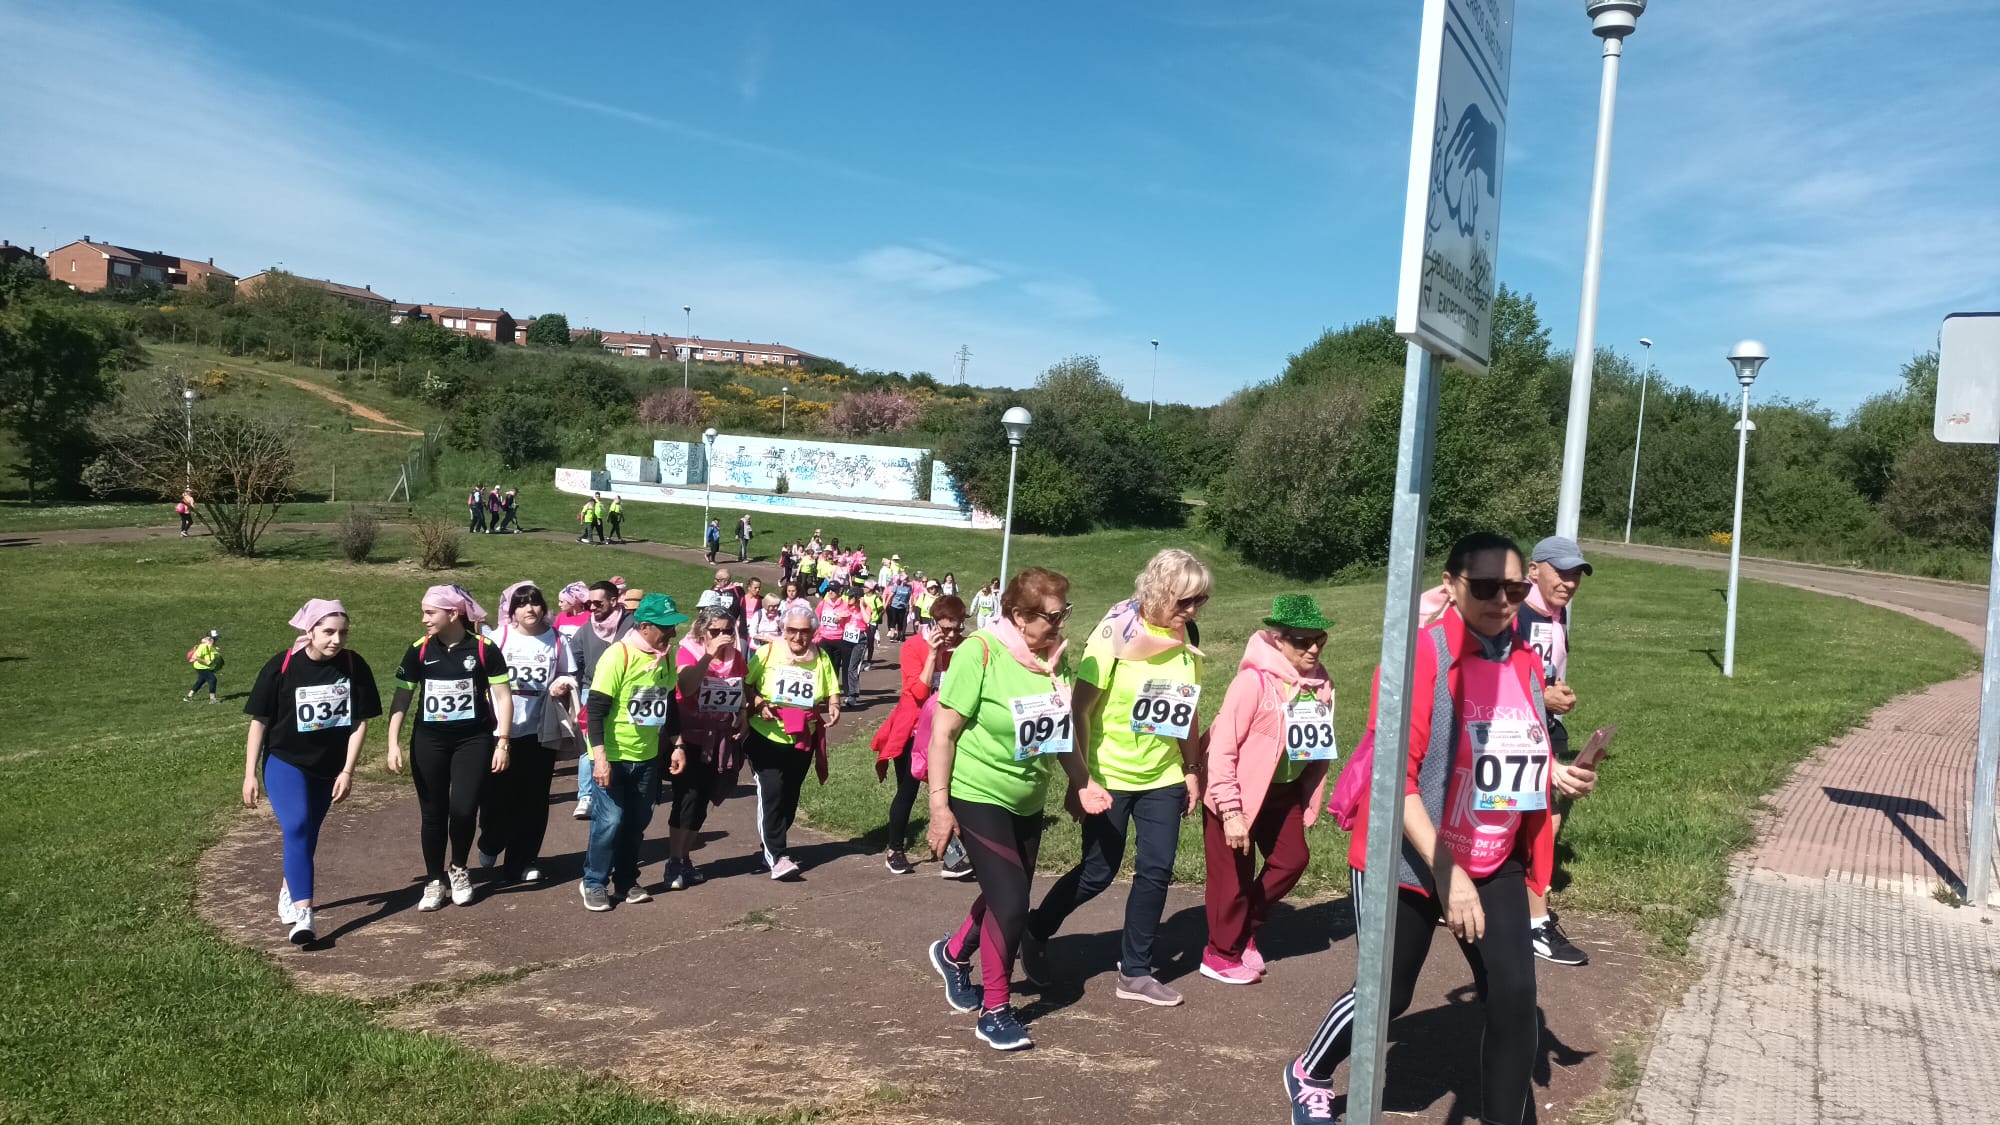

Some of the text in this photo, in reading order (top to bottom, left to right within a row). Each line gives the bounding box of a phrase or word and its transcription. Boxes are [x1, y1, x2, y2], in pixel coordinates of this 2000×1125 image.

[1438, 291, 1479, 338] EXCREMENTOS
[844, 630, 859, 640] 051
[506, 666, 547, 683] 033
[701, 690, 741, 706] 137
[776, 679, 813, 699] 148
[298, 699, 349, 722] 034
[426, 694, 472, 713] 032
[627, 700, 665, 717] 030
[1132, 698, 1192, 727] 098
[1020, 713, 1070, 747] 091
[1288, 723, 1333, 749] 093
[1475, 755, 1547, 793] 077
[1475, 839, 1489, 849] DE
